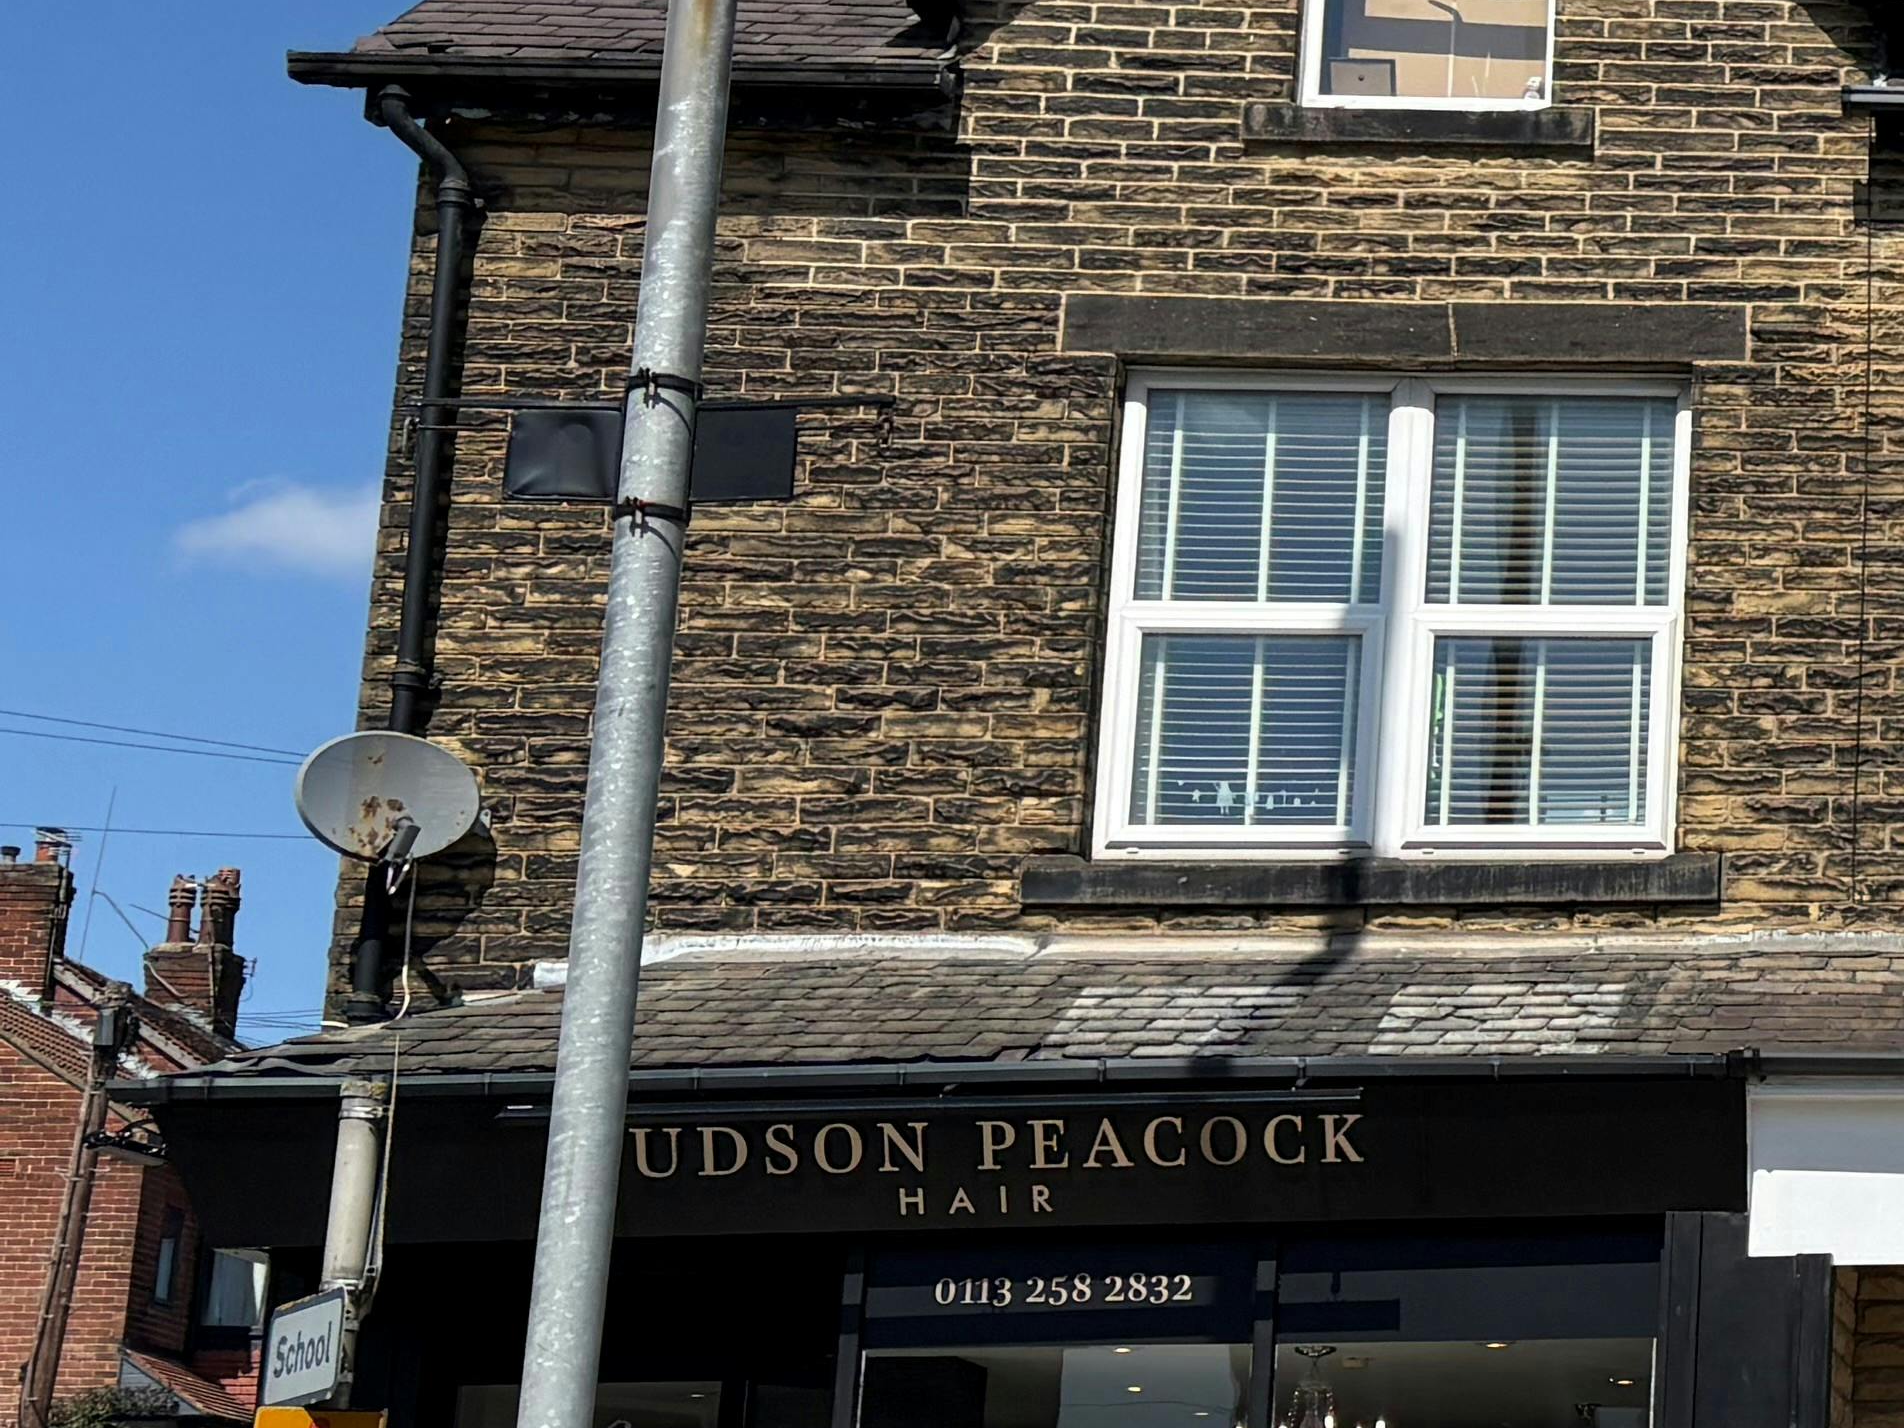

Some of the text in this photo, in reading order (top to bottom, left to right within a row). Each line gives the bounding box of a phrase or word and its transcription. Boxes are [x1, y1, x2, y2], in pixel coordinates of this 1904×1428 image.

[628, 1114, 1365, 1178] UDSON PEACOCK
[899, 1185, 1054, 1216] HAIR
[935, 1273, 1193, 1307] 0113 258 2832
[273, 1321, 333, 1379] School
